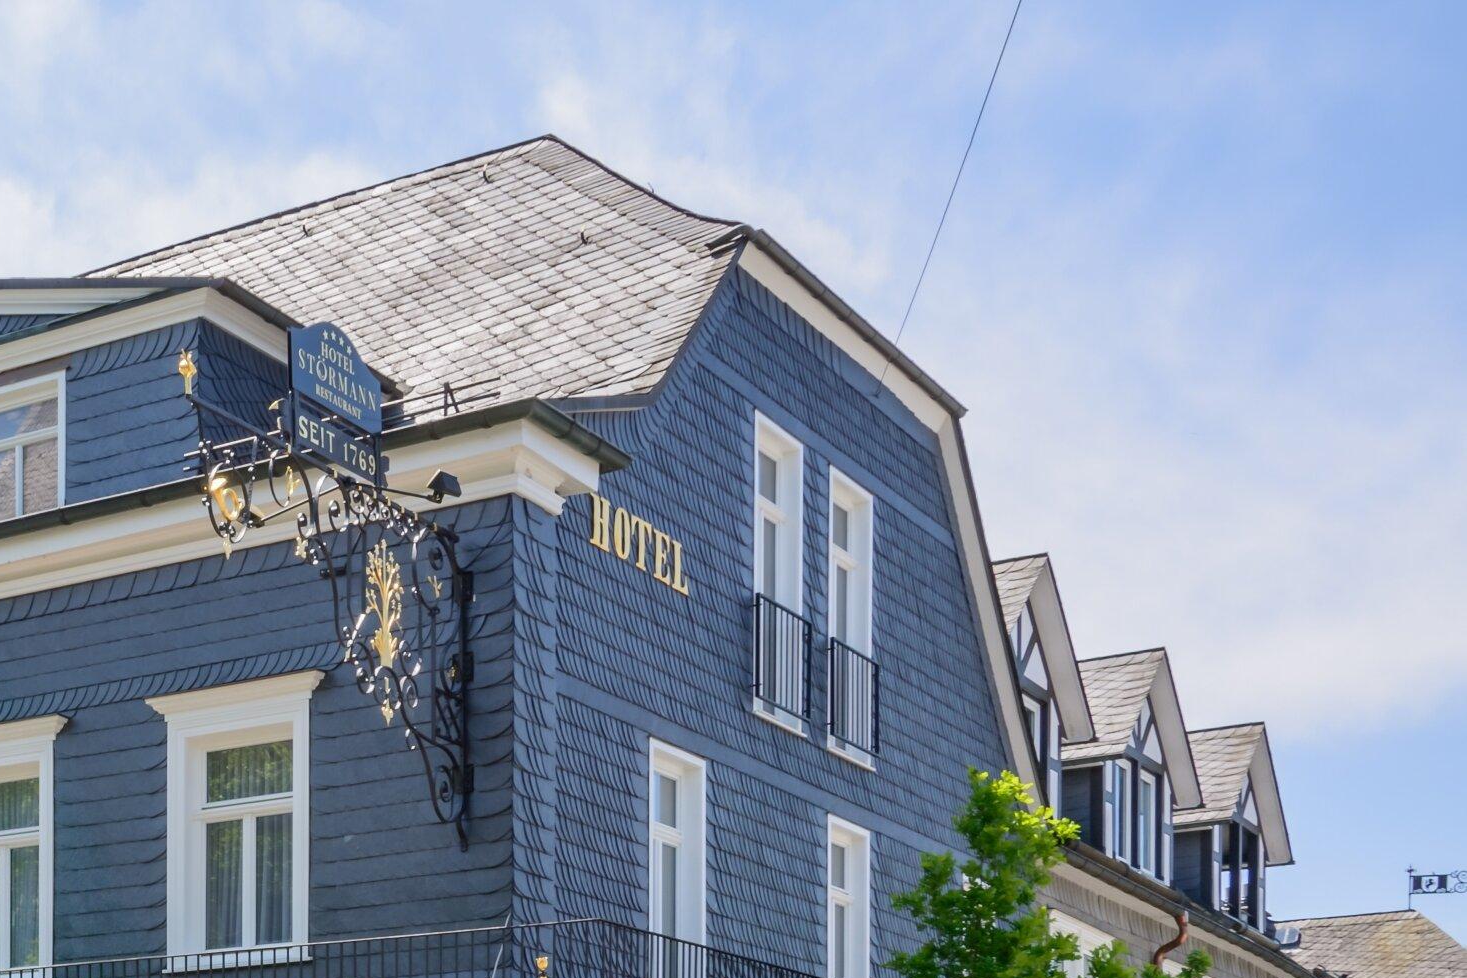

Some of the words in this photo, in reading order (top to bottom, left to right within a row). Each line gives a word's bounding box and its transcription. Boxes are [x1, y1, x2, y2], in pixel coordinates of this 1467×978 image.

[298, 348, 377, 412] STÖRMANN
[321, 342, 355, 376] HOTEL
[315, 383, 362, 420] RESTAURANT
[298, 415, 336, 454] SEIT
[343, 442, 376, 476] 1769
[589, 491, 689, 596] HOTEL
